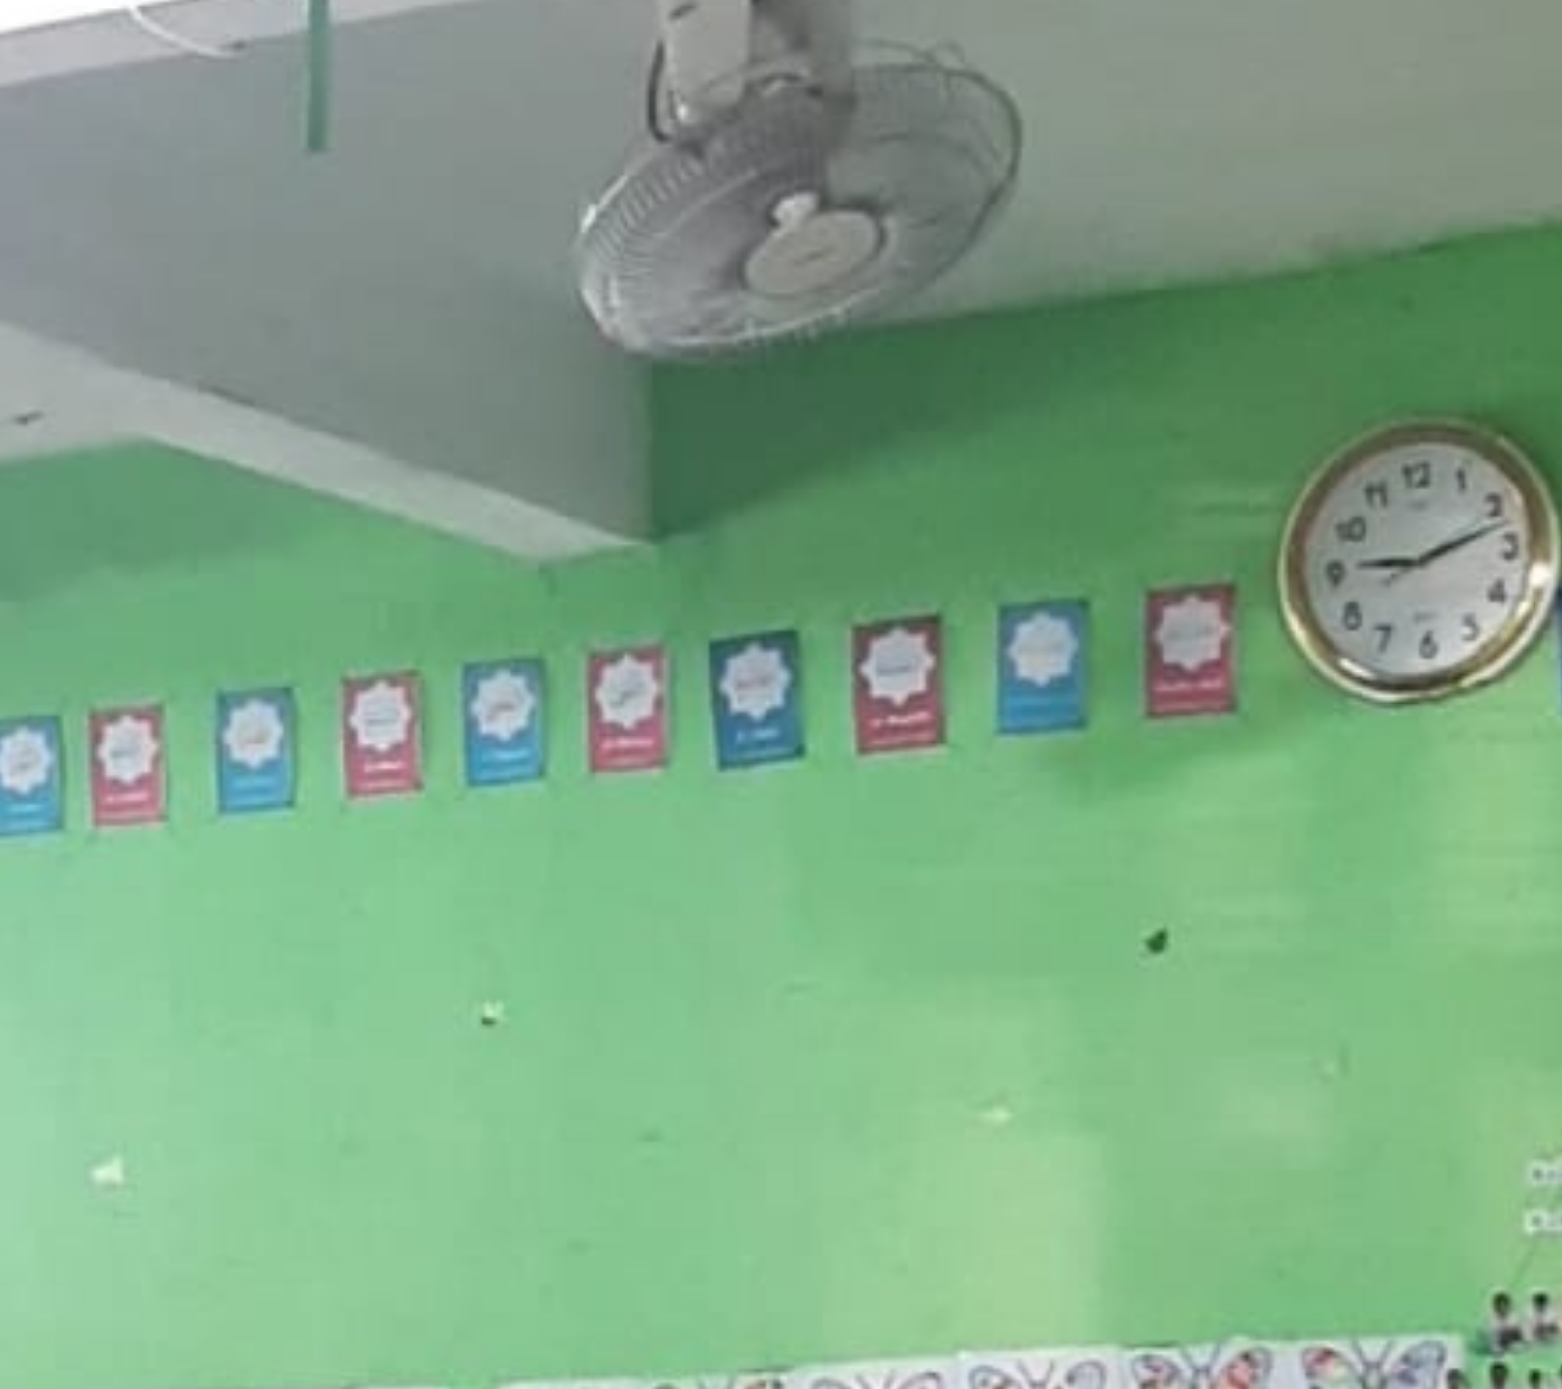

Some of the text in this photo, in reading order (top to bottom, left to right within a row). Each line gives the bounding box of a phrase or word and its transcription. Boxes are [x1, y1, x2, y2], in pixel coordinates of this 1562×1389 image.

[1402, 462, 1430, 489] 12
[1456, 469, 1466, 492] 1
[1365, 481, 1387, 507] 11
[1485, 493, 1503, 517] 2
[1335, 516, 1365, 542] 10
[1501, 532, 1518, 560] 3
[1326, 561, 1345, 586] 9
[1487, 578, 1506, 602] 4
[1342, 601, 1361, 630] 8
[1462, 613, 1479, 641] 5
[1374, 625, 1393, 651] 7
[1419, 631, 1437, 659] 6
